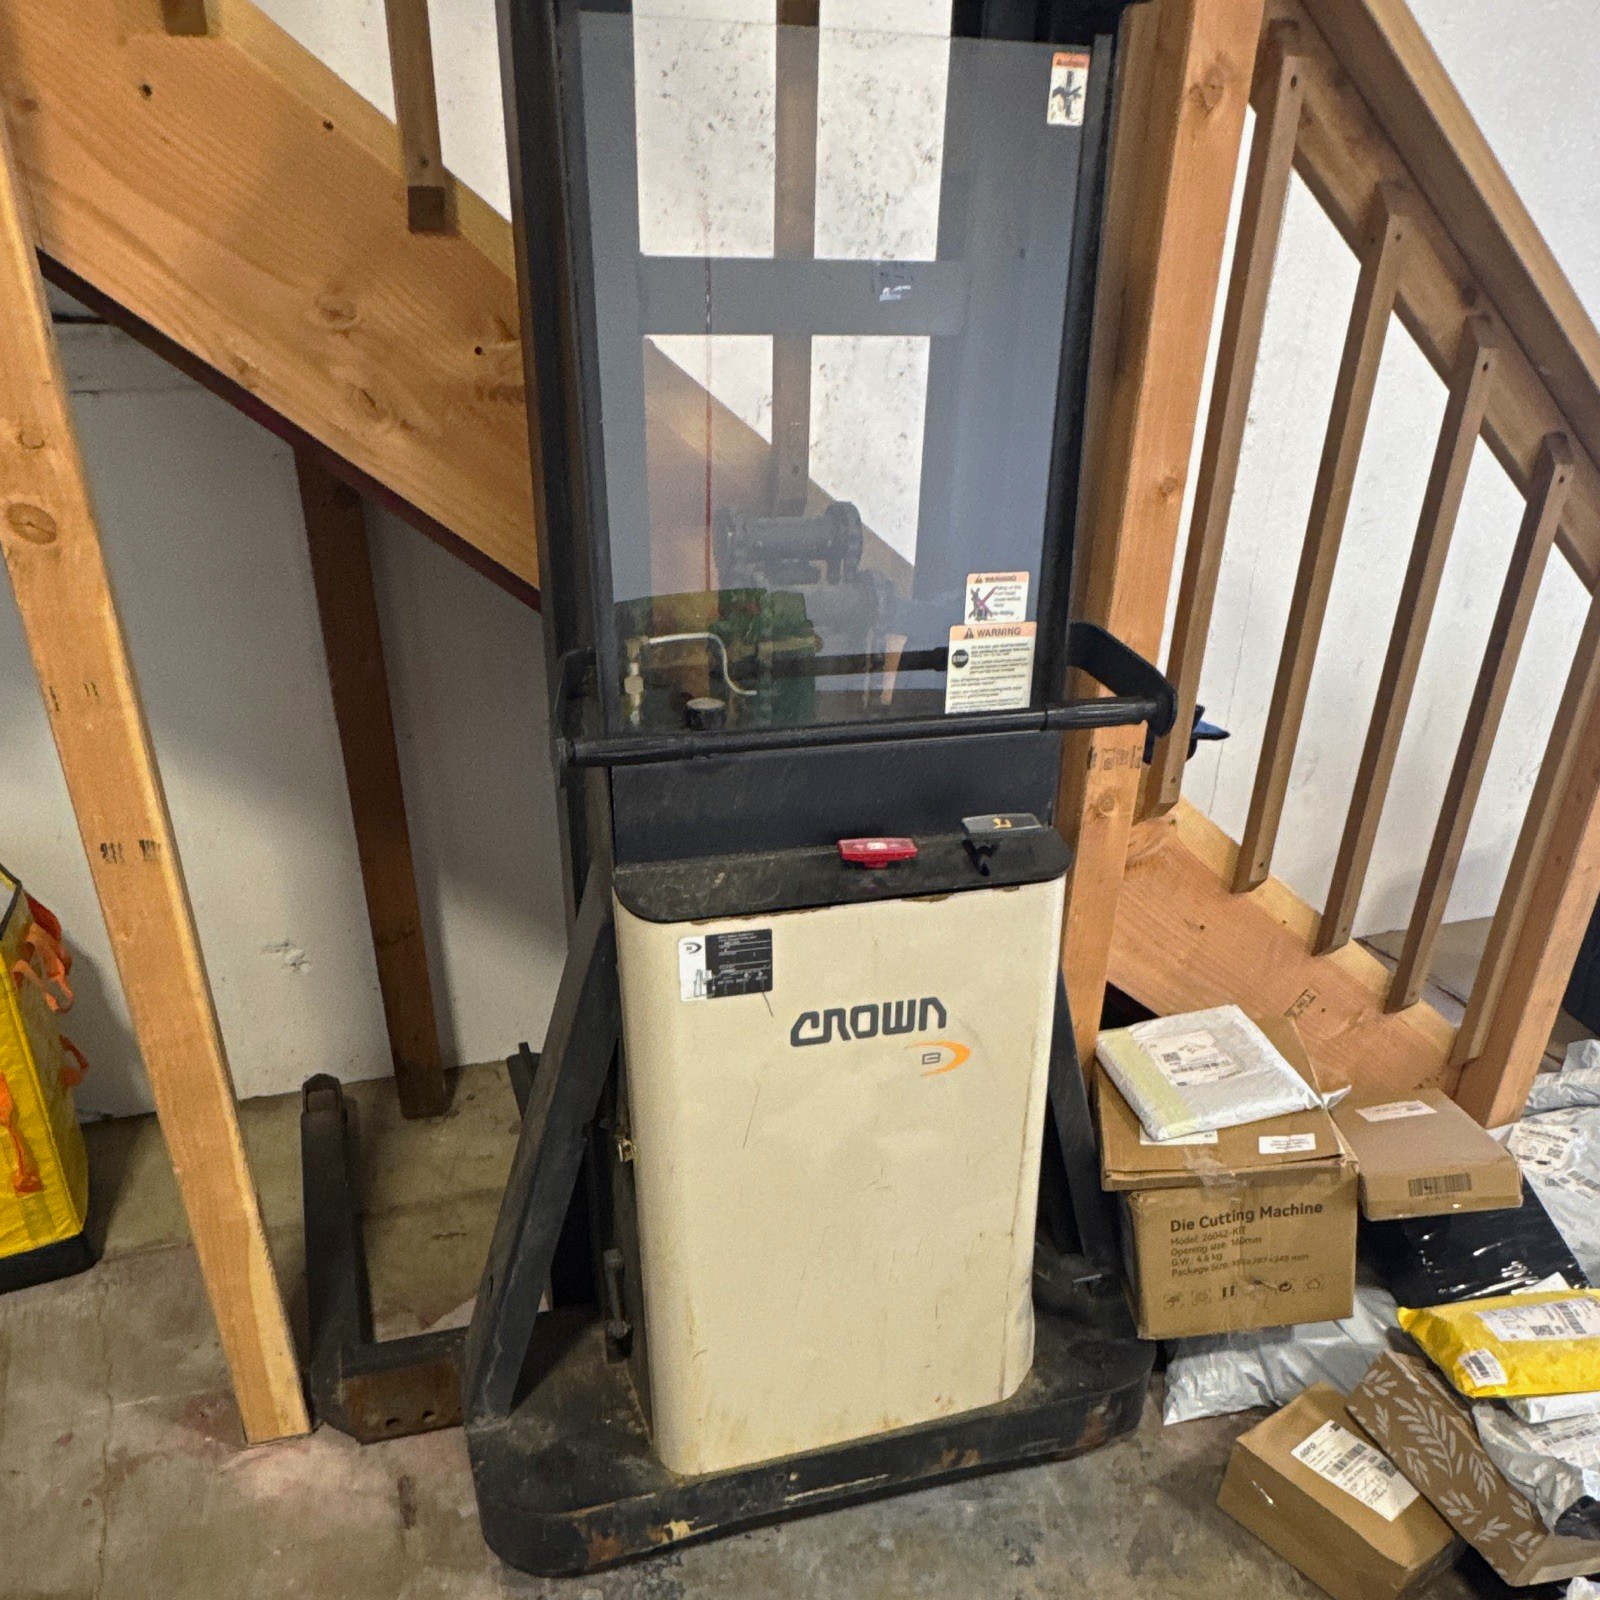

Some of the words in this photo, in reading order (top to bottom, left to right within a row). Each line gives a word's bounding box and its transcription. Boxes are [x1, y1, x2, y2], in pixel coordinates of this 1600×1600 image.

[977, 626, 1021, 638] WARNING
[1170, 1219, 1195, 1233] Die
[1199, 1209, 1255, 1228] Cutting
[1259, 1202, 1323, 1219] Machine
[1170, 1245, 1208, 1258] Opening
[1171, 1264, 1209, 1278] Package
